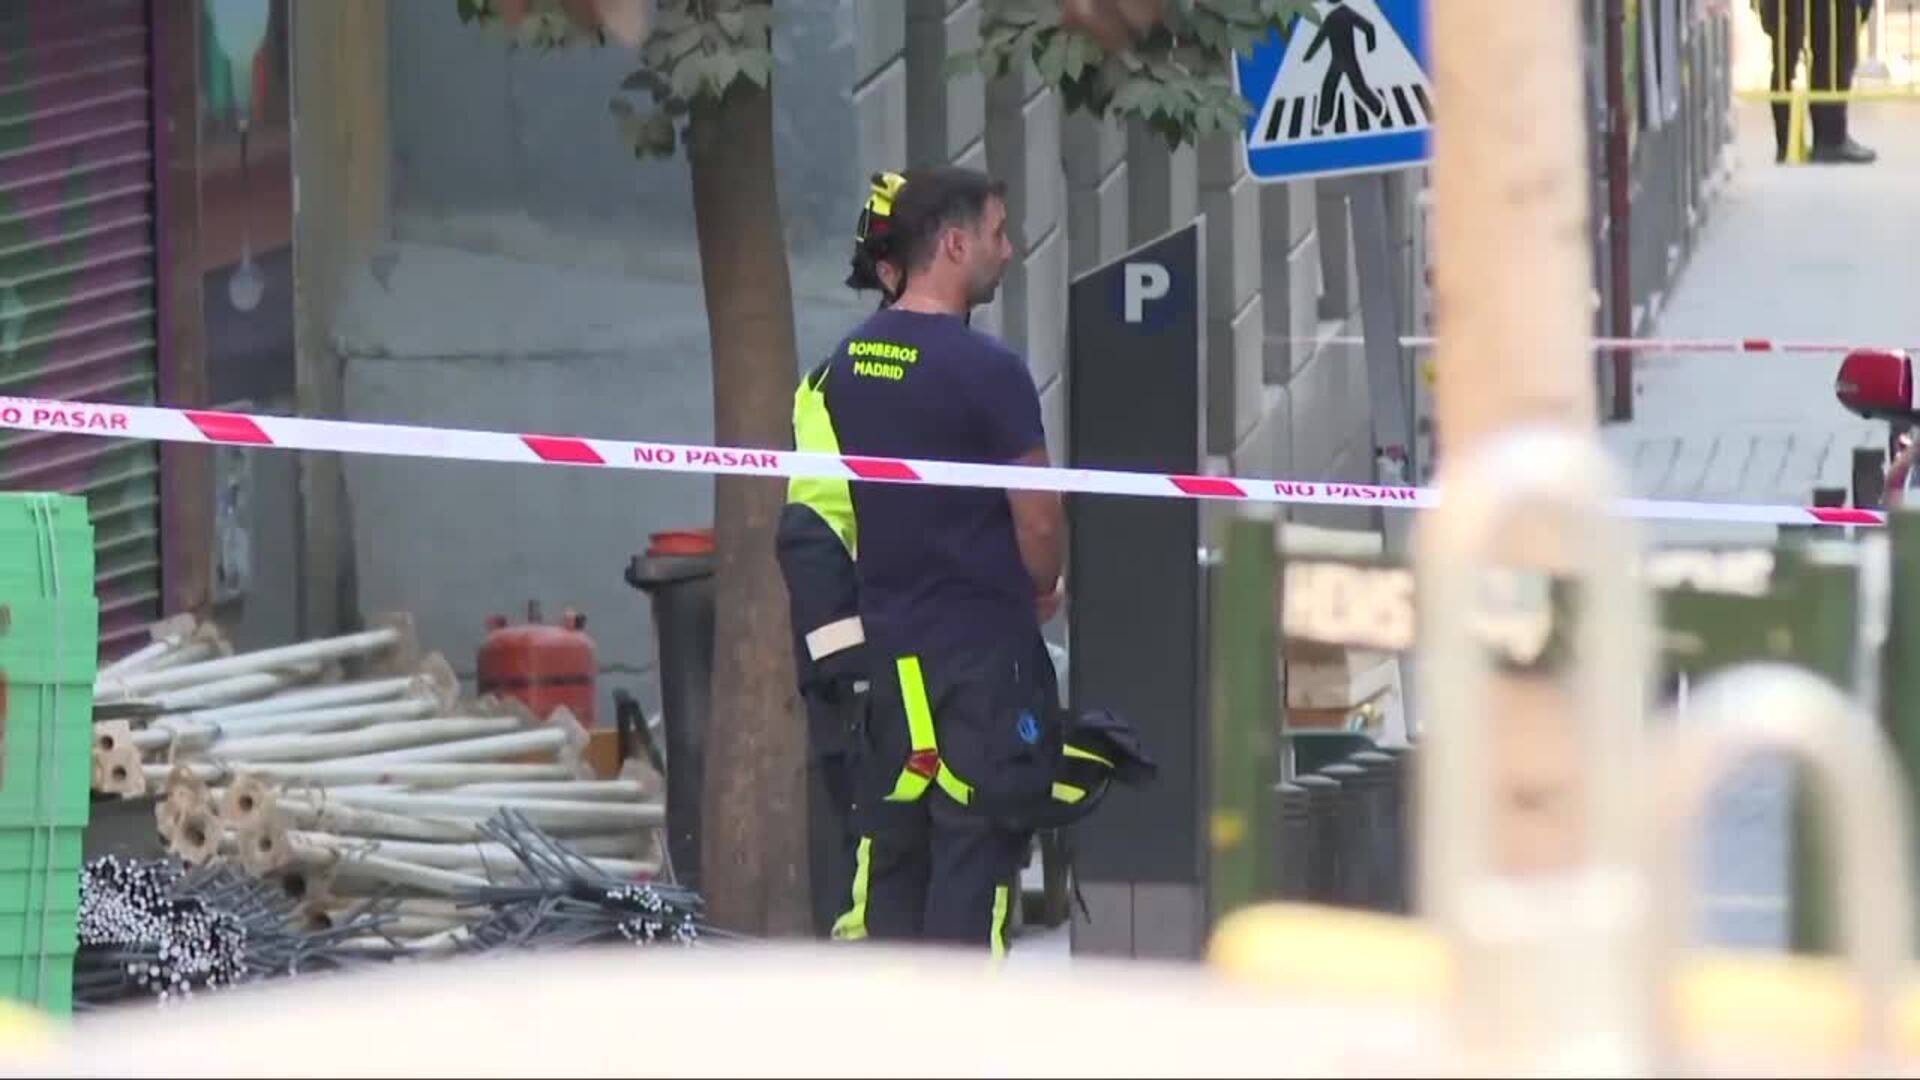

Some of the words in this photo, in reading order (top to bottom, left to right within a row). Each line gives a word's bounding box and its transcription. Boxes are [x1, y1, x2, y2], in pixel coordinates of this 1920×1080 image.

[1124, 263, 1171, 323] P
[848, 341, 919, 363] BOMBEROS
[853, 360, 904, 380] MADRID
[33, 408, 128, 430] PASAR
[634, 447, 675, 464] NO
[686, 449, 778, 468] PASAR
[1274, 483, 1315, 497] NO
[1326, 484, 1416, 500] PASAR
